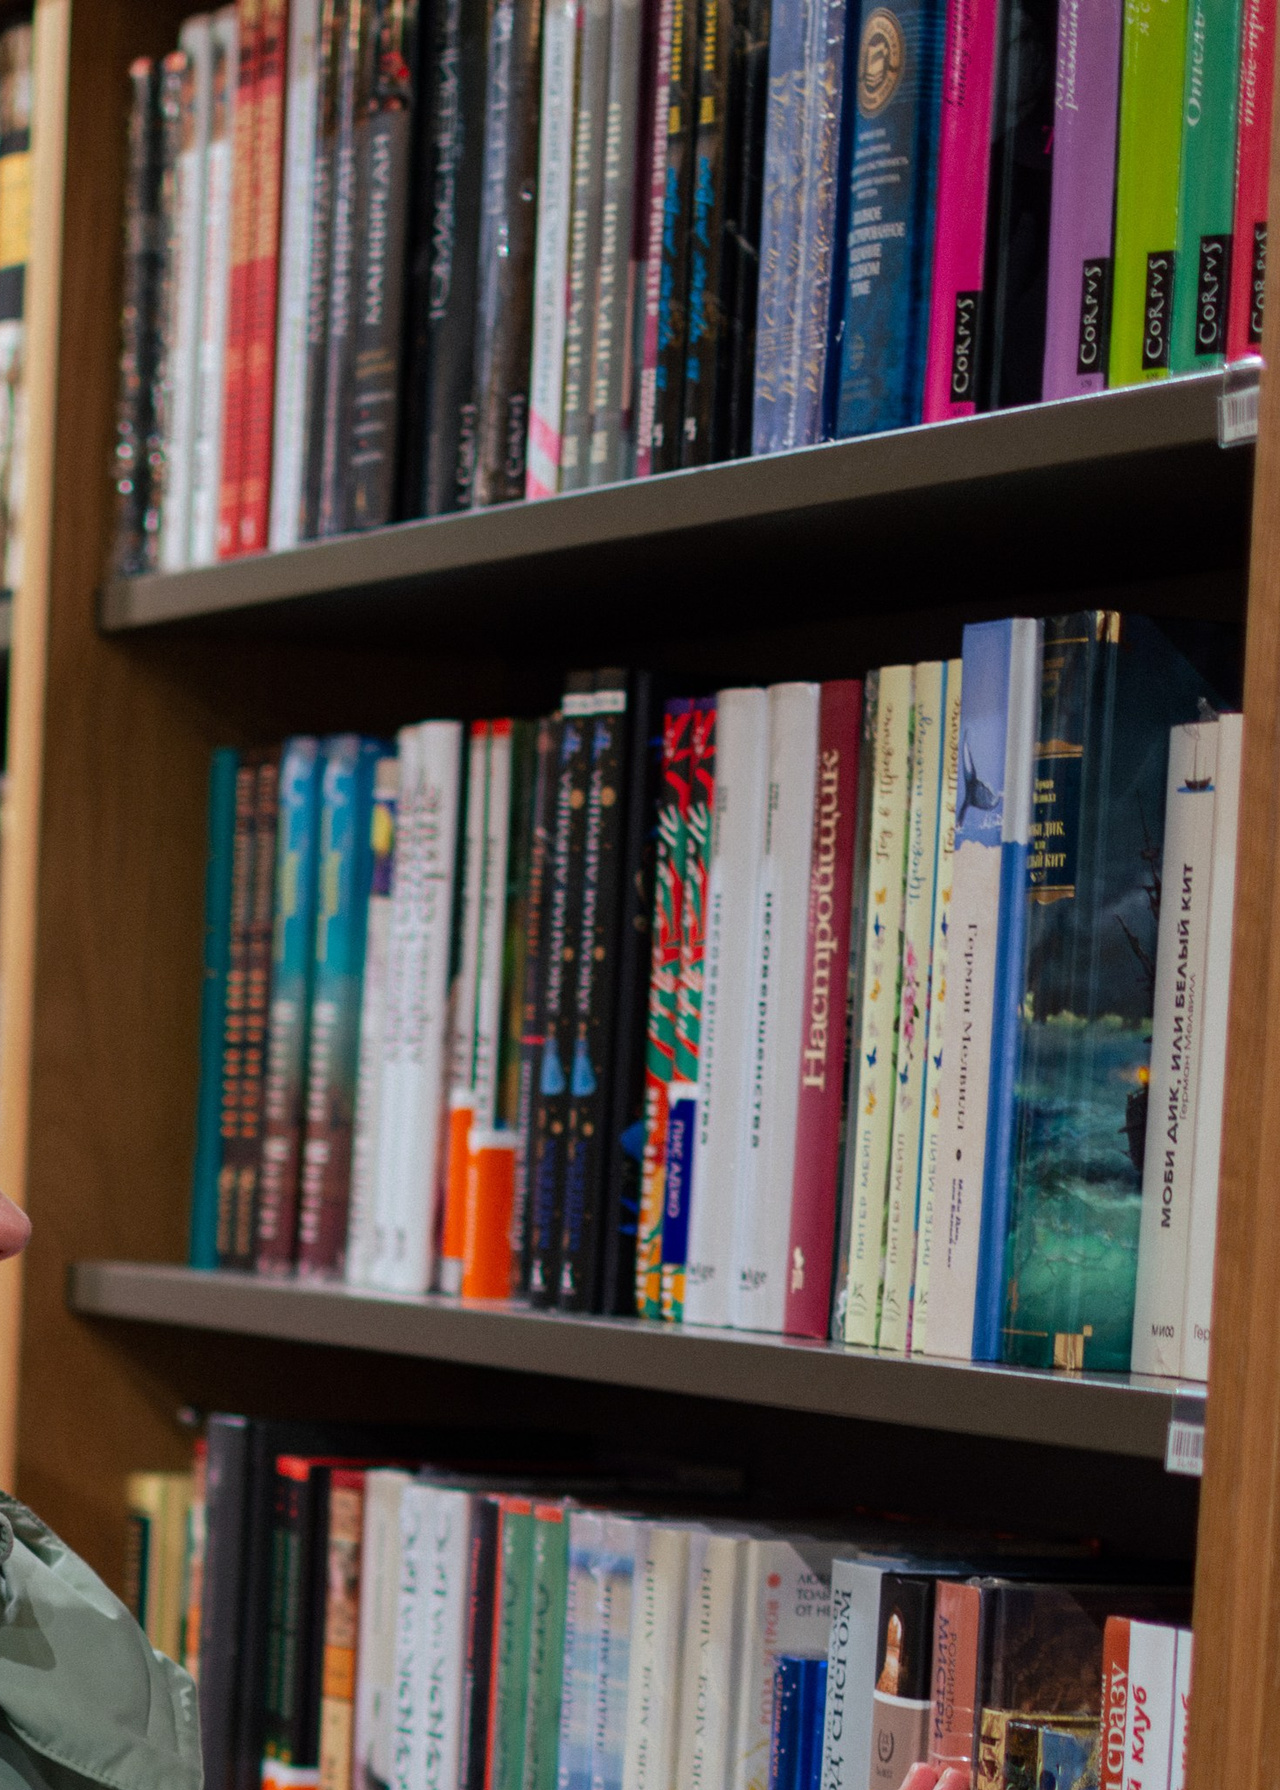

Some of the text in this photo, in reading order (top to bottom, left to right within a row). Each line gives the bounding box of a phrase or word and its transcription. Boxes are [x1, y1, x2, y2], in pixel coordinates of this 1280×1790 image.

[801, 748, 841, 1092] Настройщик
[1045, 853, 1067, 867] КИТ
[957, 924, 978, 1130] Герман Мелвилл
[1160, 864, 1193, 1228] МОБИ ДИК, ИЛИ БЕЛЫЙ КИТ
[1178, 1056, 1193, 1120] Герман
[832, 1591, 852, 1742] СНЕГОМ
[934, 1615, 950, 1739] МИСТРИ
[1105, 1662, 1129, 1774] сразу
[1131, 1684, 1152, 1765] клуб
